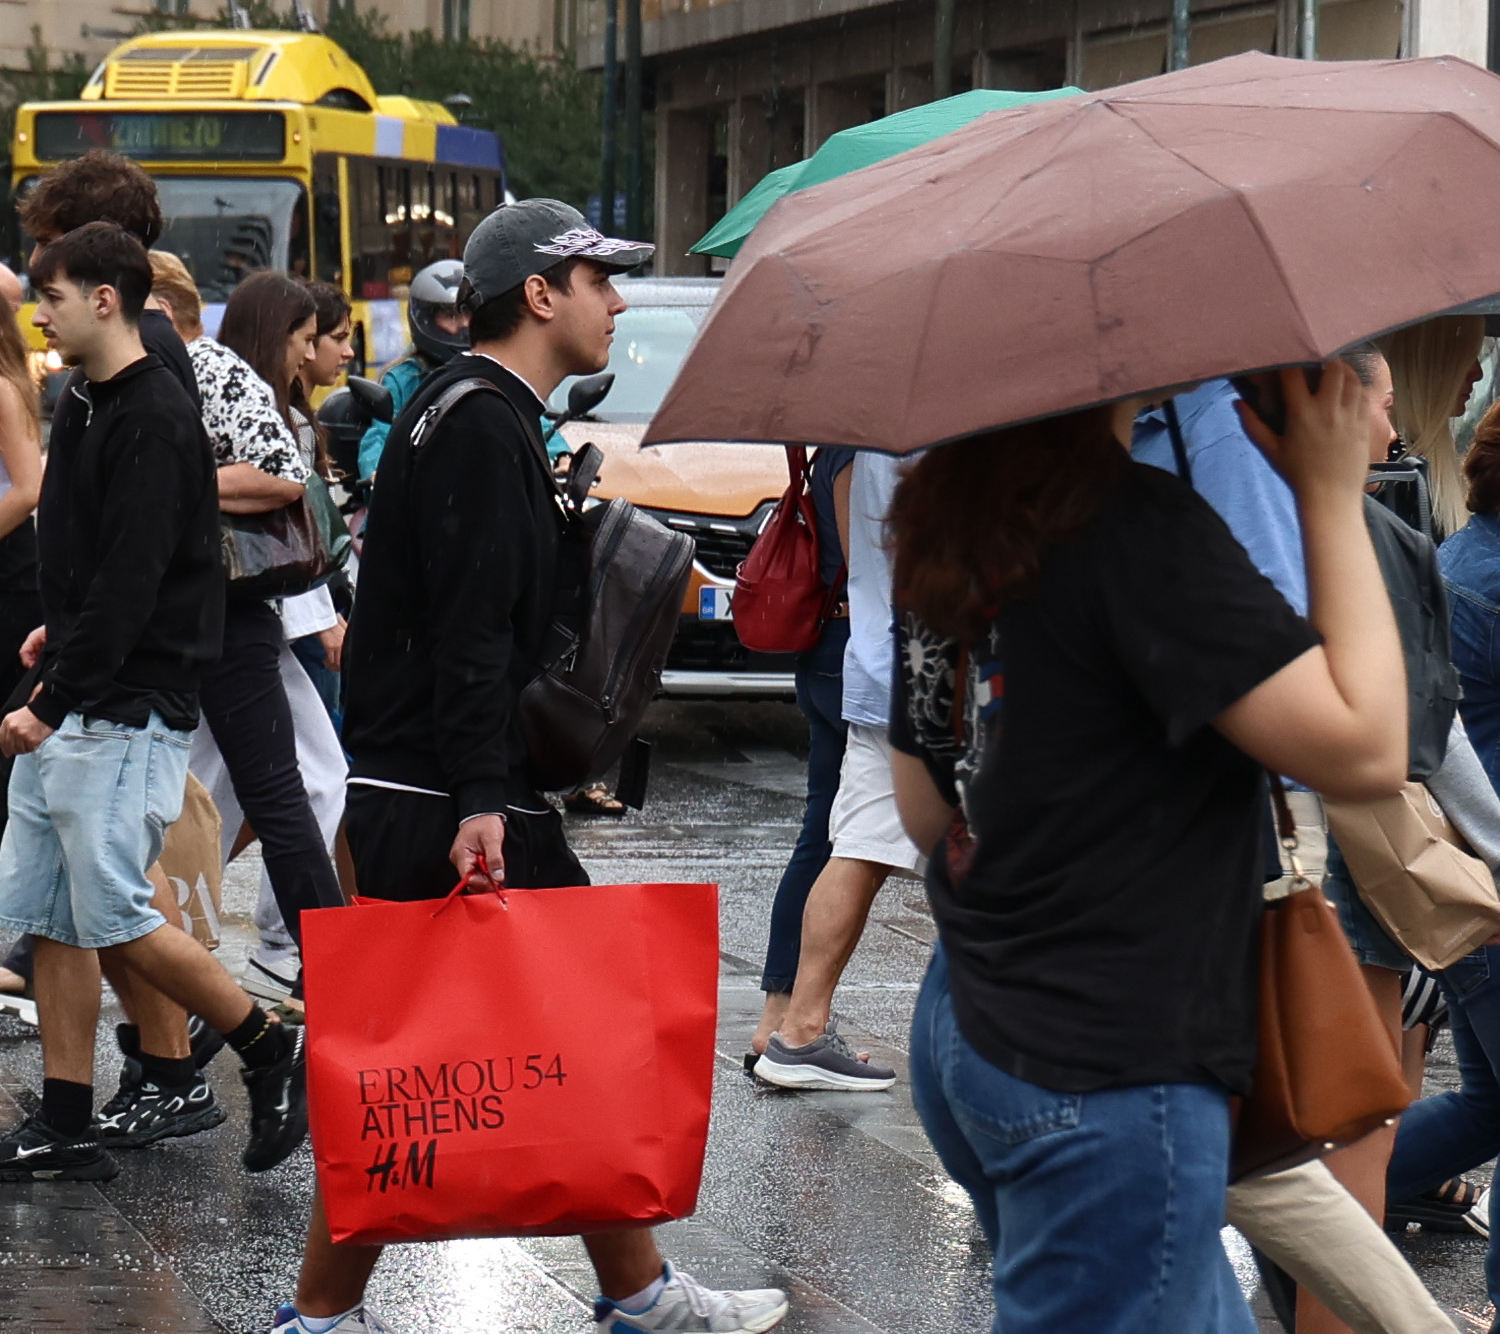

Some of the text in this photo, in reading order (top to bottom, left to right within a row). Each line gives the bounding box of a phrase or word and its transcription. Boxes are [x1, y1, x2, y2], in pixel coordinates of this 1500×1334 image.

[358, 1053, 567, 1104] ERMOU 54
[361, 1095, 505, 1141] ATHENS
[364, 1139, 437, 1194] H&M
